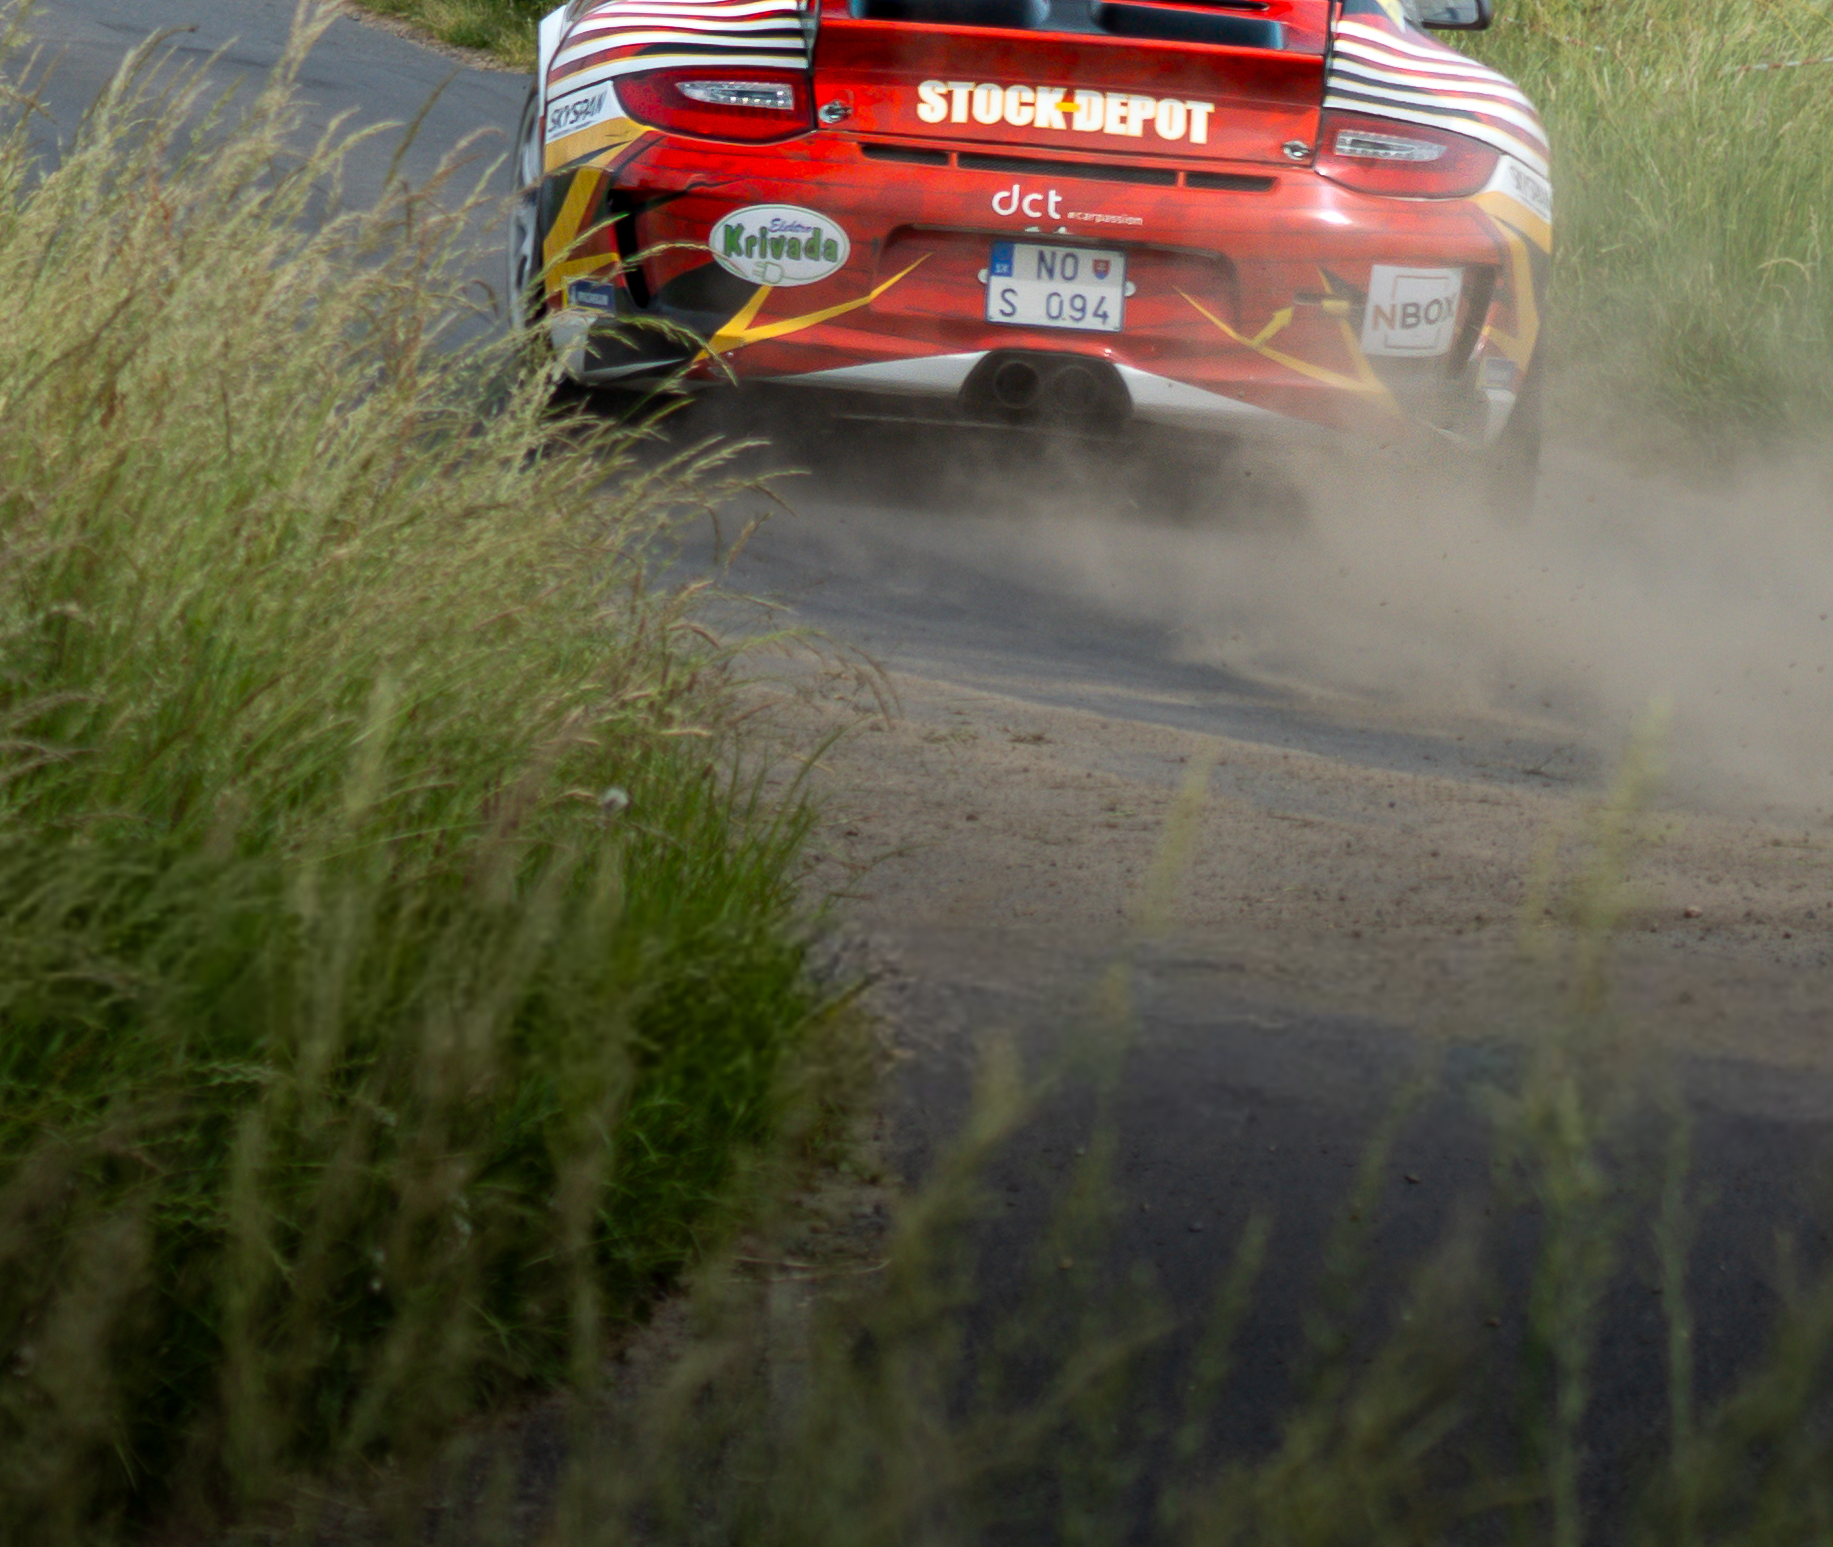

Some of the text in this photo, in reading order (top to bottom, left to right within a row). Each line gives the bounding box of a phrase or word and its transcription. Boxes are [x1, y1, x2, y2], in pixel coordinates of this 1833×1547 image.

[991, 184, 1063, 220] dct
[723, 222, 839, 263] Krivada
[999, 287, 1110, 325] S 094
